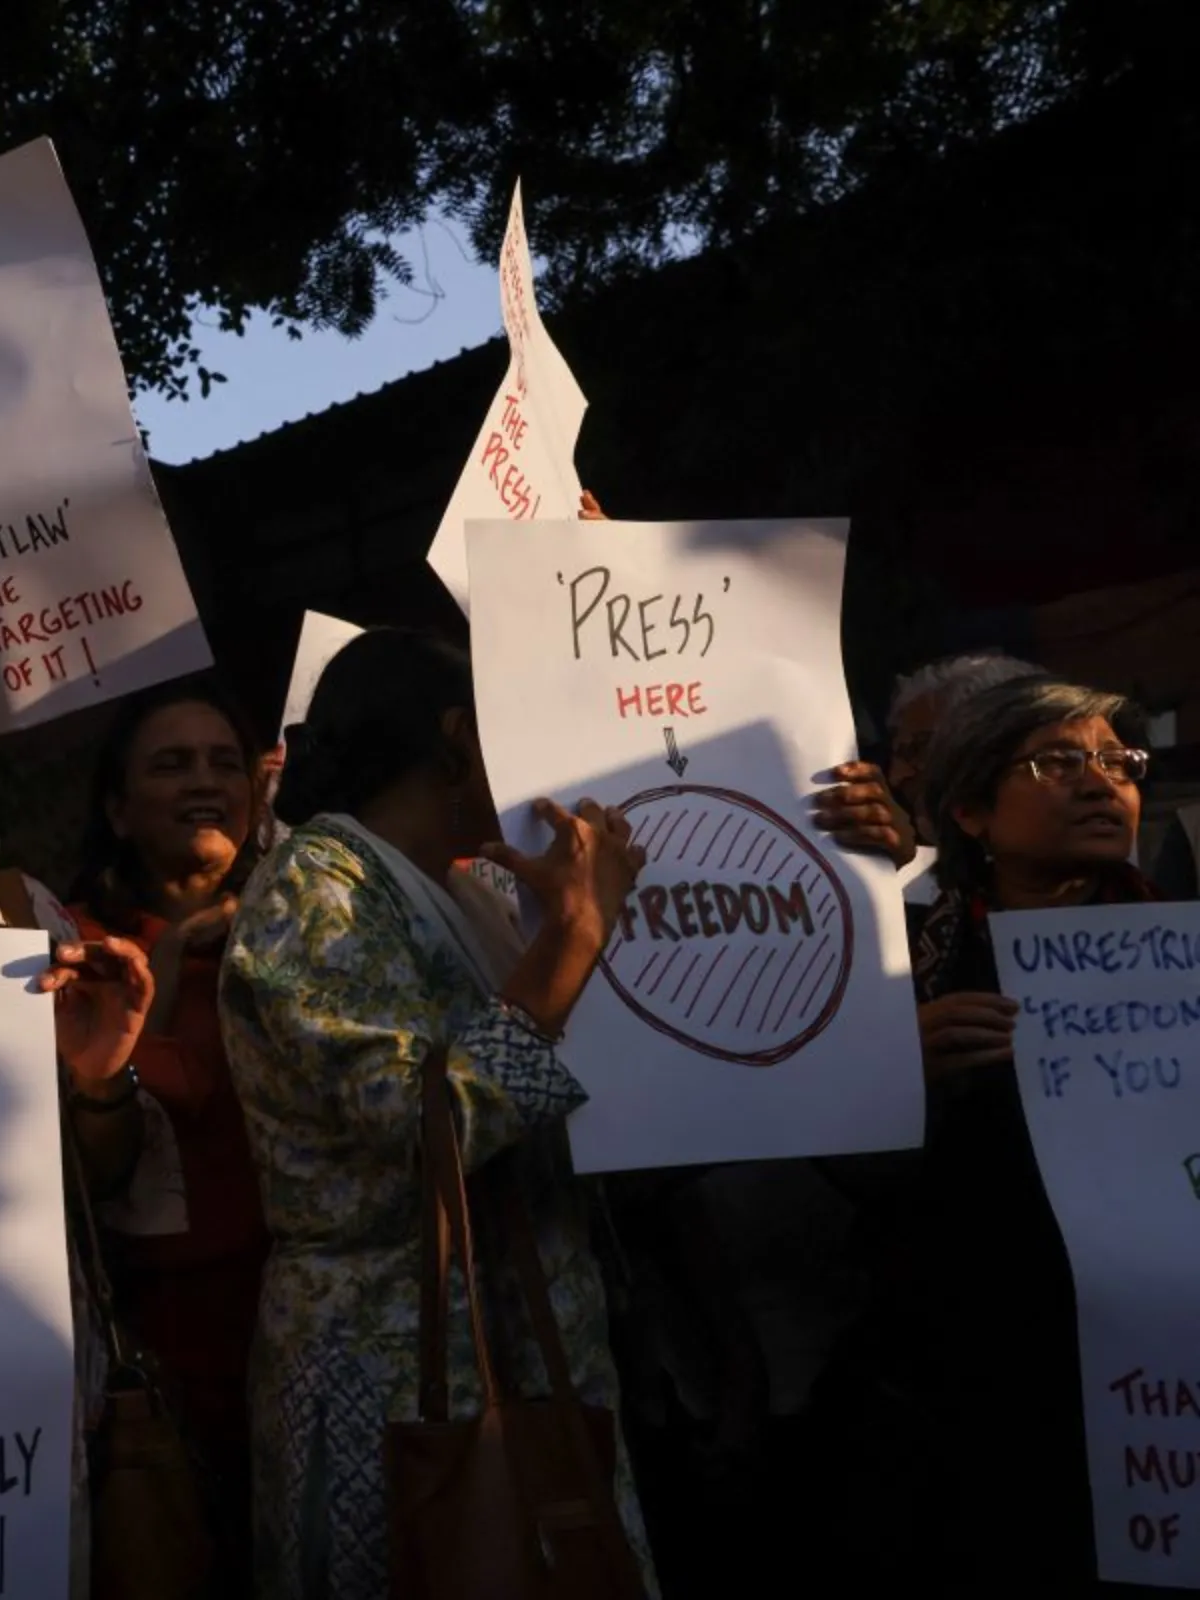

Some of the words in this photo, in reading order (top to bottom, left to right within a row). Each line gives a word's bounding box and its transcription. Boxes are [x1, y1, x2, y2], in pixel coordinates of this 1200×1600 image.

[500, 394, 529, 450] THE
[481, 431, 542, 521] PRESS!
[2, 657, 33, 692] OF
[616, 681, 708, 718] HERE
[1038, 1055, 1071, 1098] IF
[1094, 1049, 1182, 1099] YOU
[1109, 1368, 1200, 1418] THA
[1125, 1444, 1200, 1494] MU
[1130, 1513, 1180, 1556] OF
